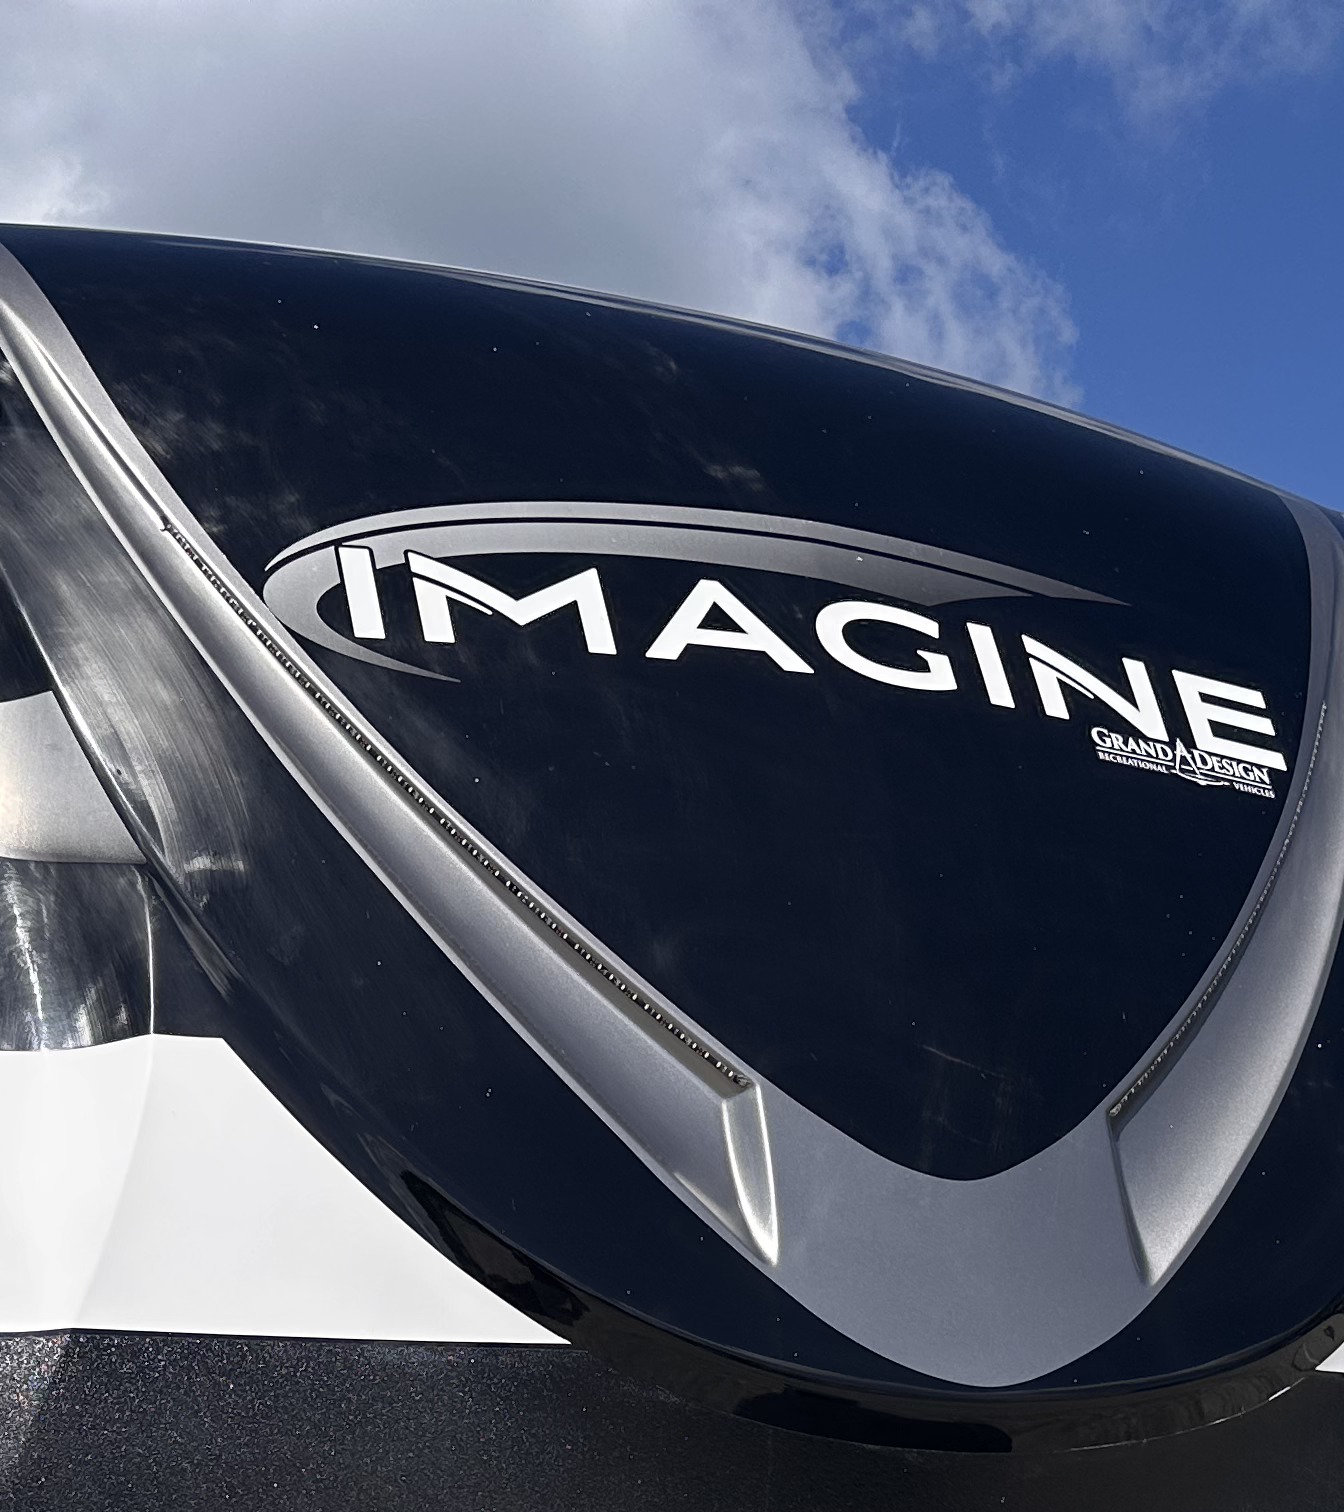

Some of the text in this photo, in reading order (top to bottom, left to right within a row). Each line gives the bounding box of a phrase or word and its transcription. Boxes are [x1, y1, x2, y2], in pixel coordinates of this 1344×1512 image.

[337, 543, 1288, 772] IMAGINE
[1090, 726, 1271, 785] GRAND DESIGN
[1097, 751, 1276, 799] RECREATIONAL VEHICLES
